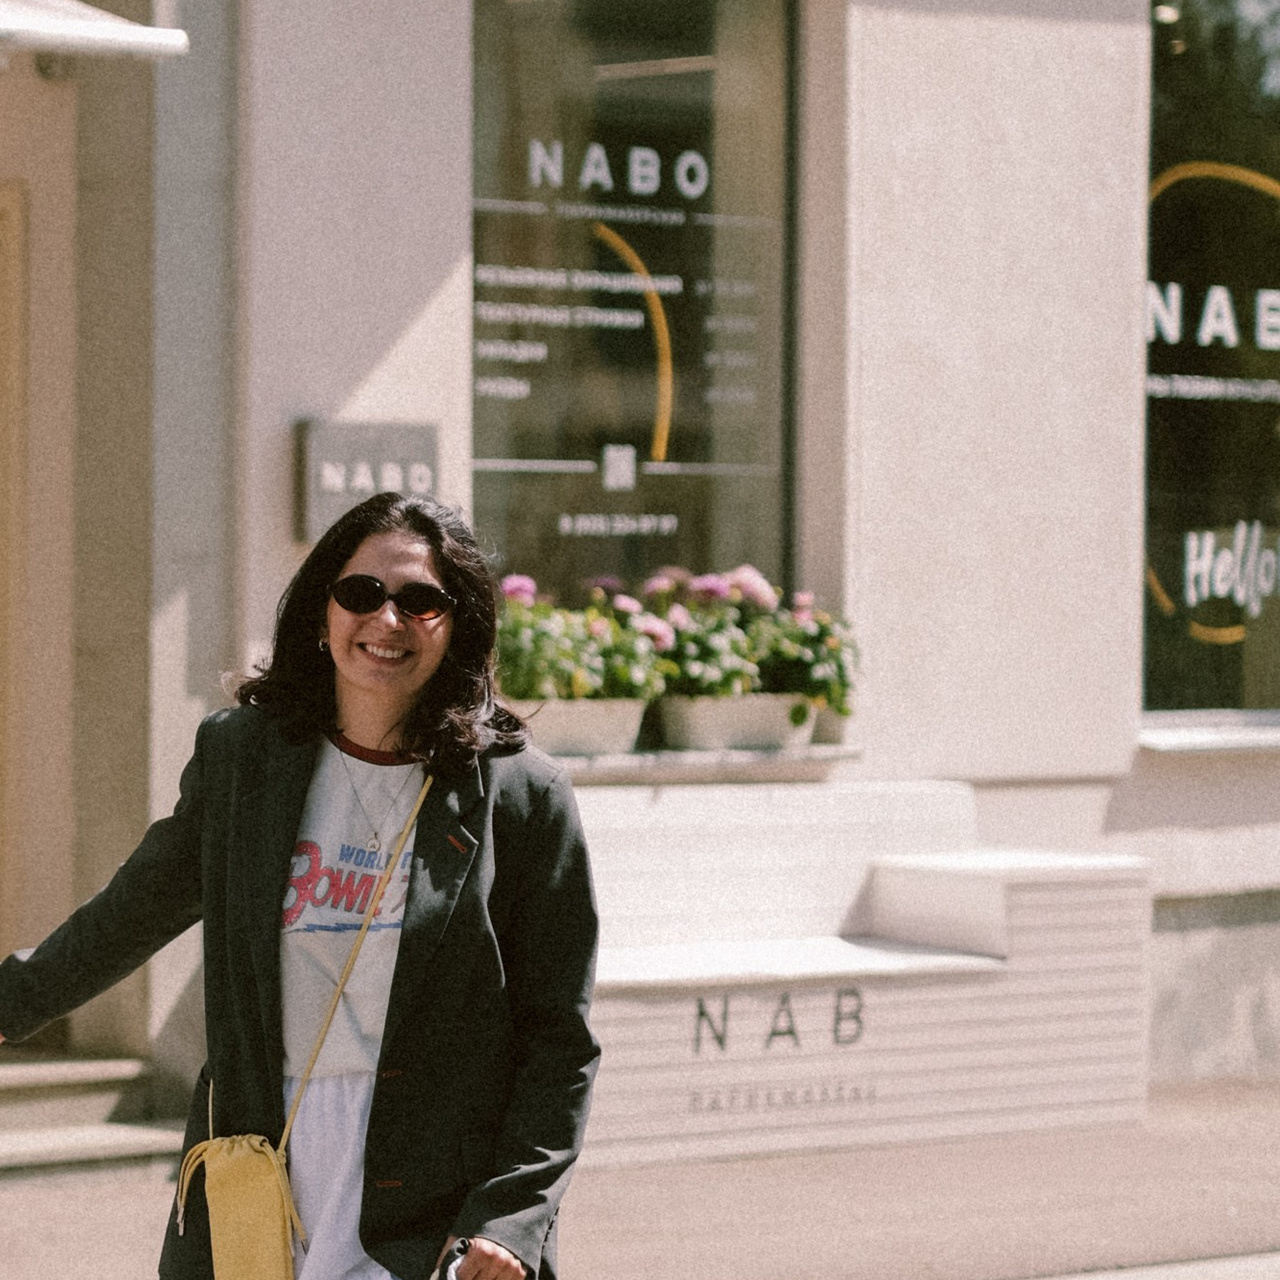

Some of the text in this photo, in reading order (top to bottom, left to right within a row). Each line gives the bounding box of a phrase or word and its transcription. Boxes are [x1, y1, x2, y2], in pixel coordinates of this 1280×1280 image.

[528, 138, 710, 200] NABO
[1184, 519, 1276, 618] Hello
[694, 987, 864, 1054] NAB
